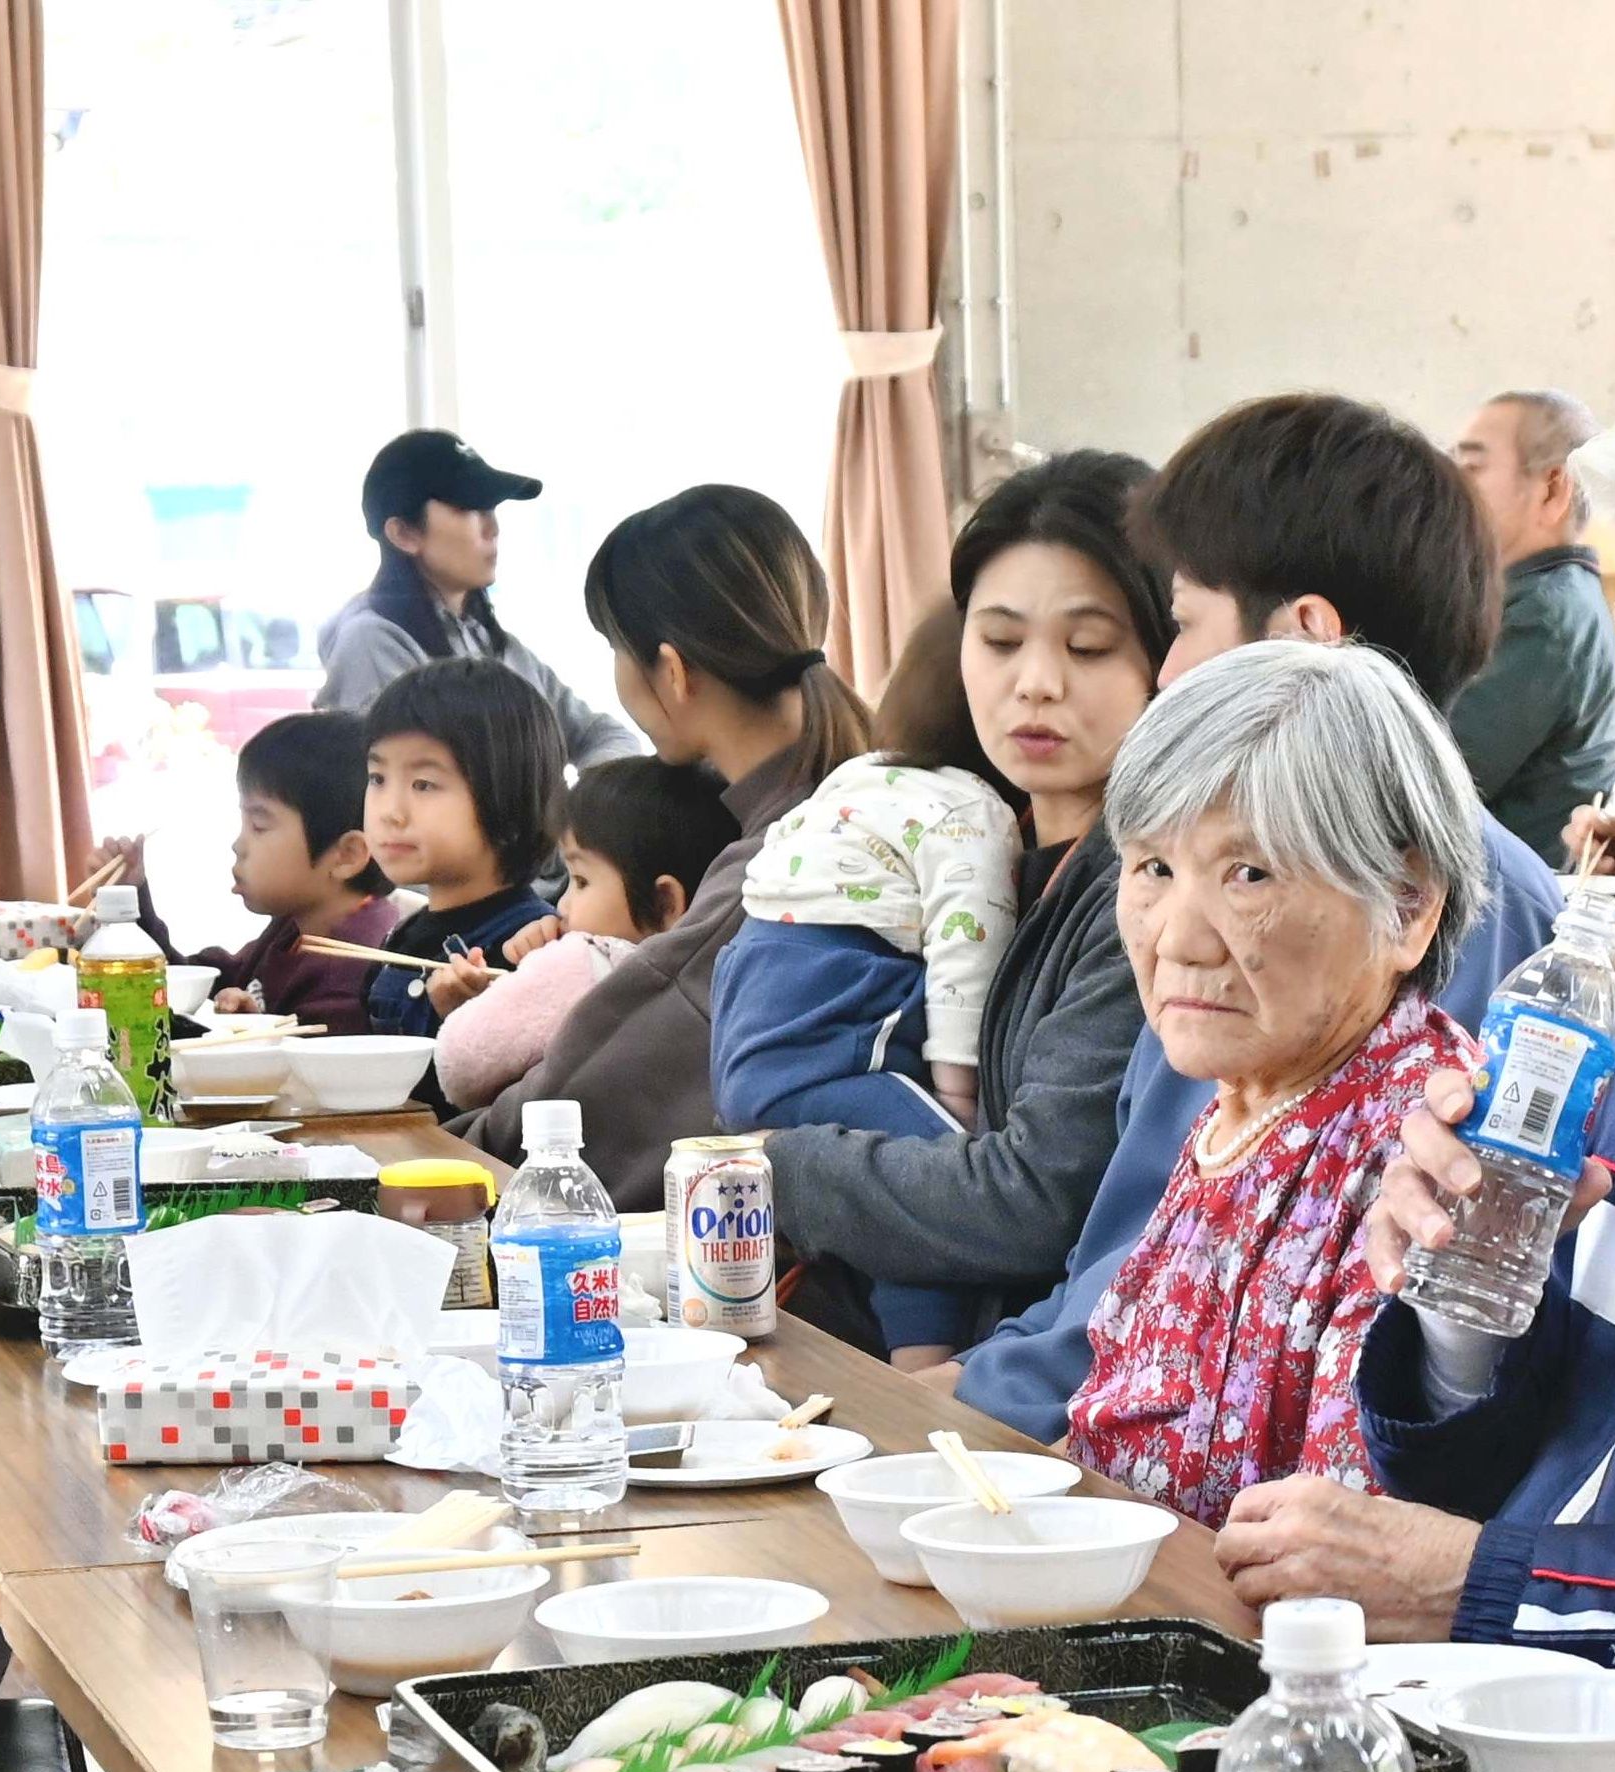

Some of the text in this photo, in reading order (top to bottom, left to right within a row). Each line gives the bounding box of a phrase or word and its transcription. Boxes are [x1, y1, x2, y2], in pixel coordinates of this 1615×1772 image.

[691, 1198, 774, 1240] Orion
[701, 1236, 771, 1263] THE DRAFT
